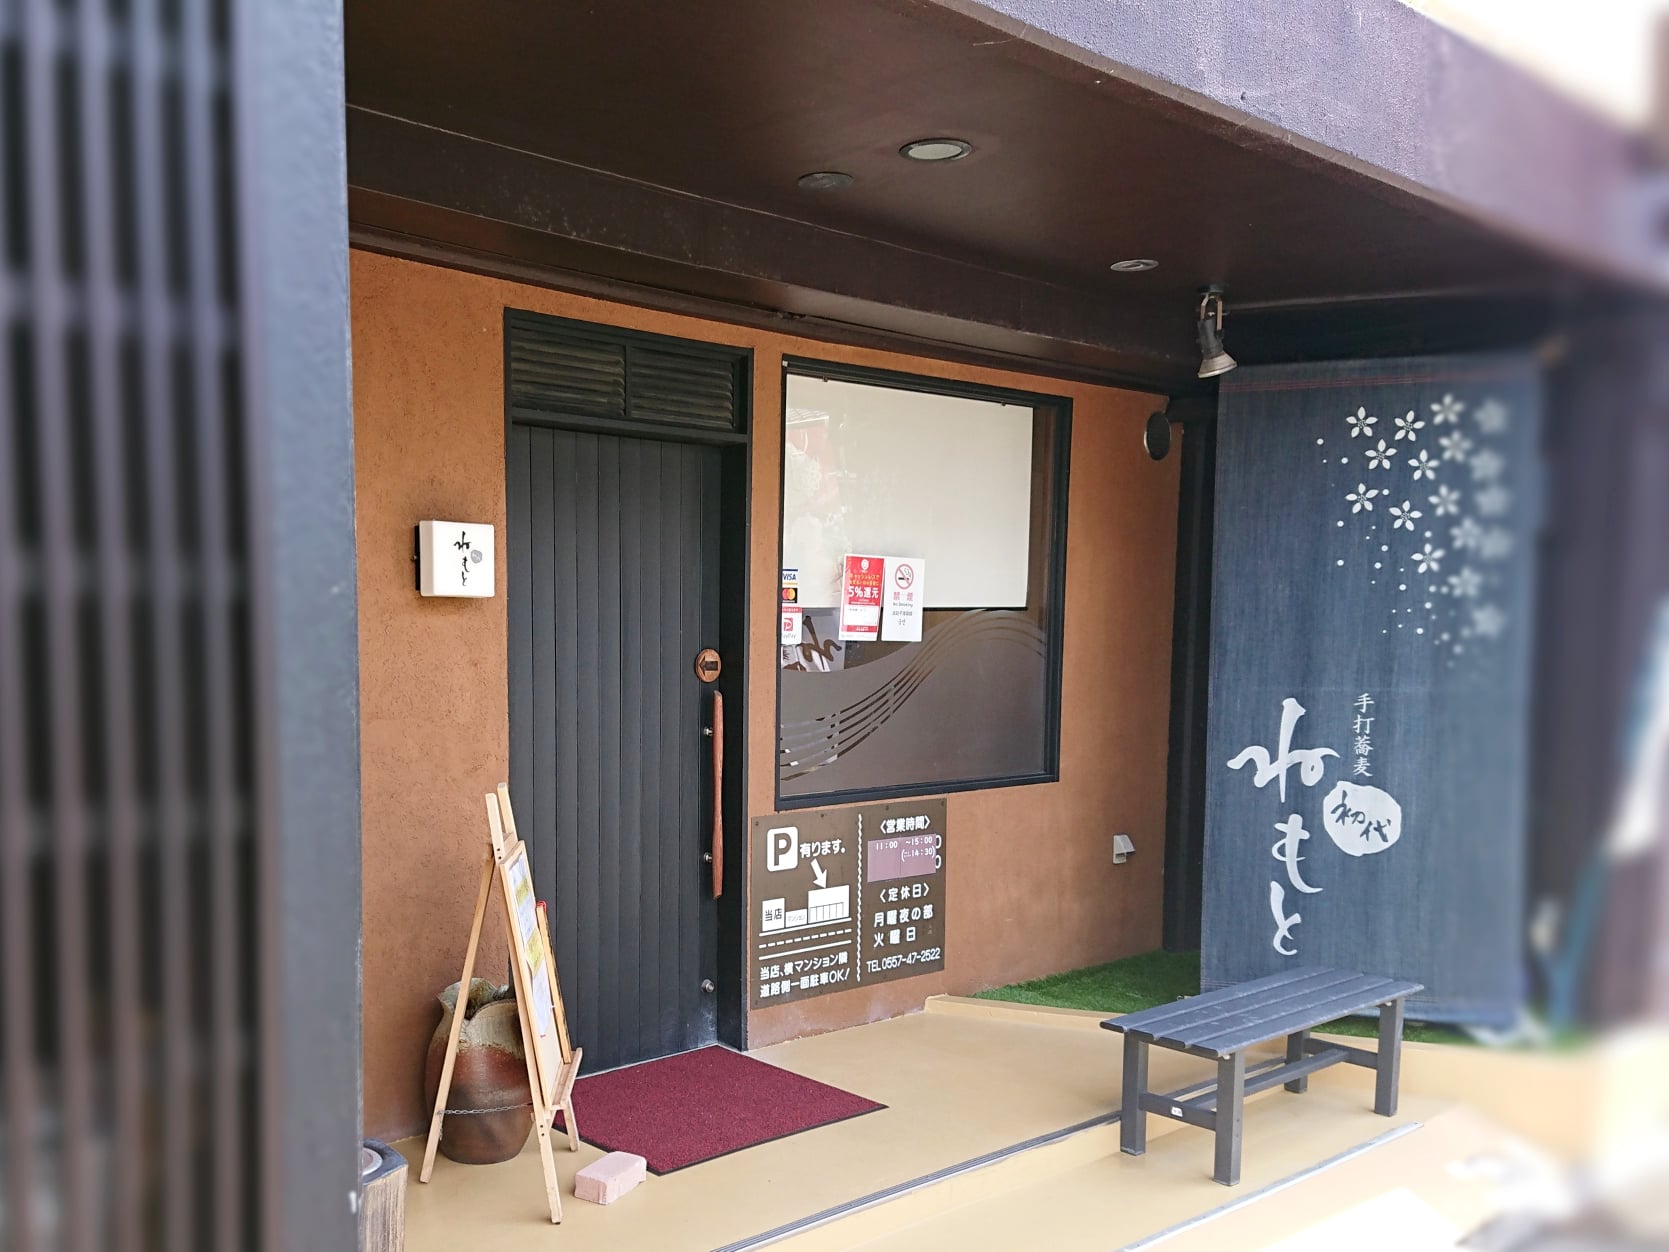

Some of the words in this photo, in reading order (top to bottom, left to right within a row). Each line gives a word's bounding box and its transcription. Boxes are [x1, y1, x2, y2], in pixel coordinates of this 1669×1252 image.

[453, 531, 472, 586] ねもと
[848, 586, 879, 598] 5%還元
[1353, 692, 1375, 777] 手打蕎麦
[1226, 697, 1340, 956] ねもと
[1331, 790, 1392, 843] 初代
[773, 831, 792, 866] P
[800, 839, 846, 858] 有ります。
[765, 908, 782, 922] 当店
[873, 904, 934, 928] 月曜夜の部
[873, 927, 916, 948] 火曜日
[866, 960, 881, 973] TEL
[881, 947, 941, 970] 0557-47-2522
